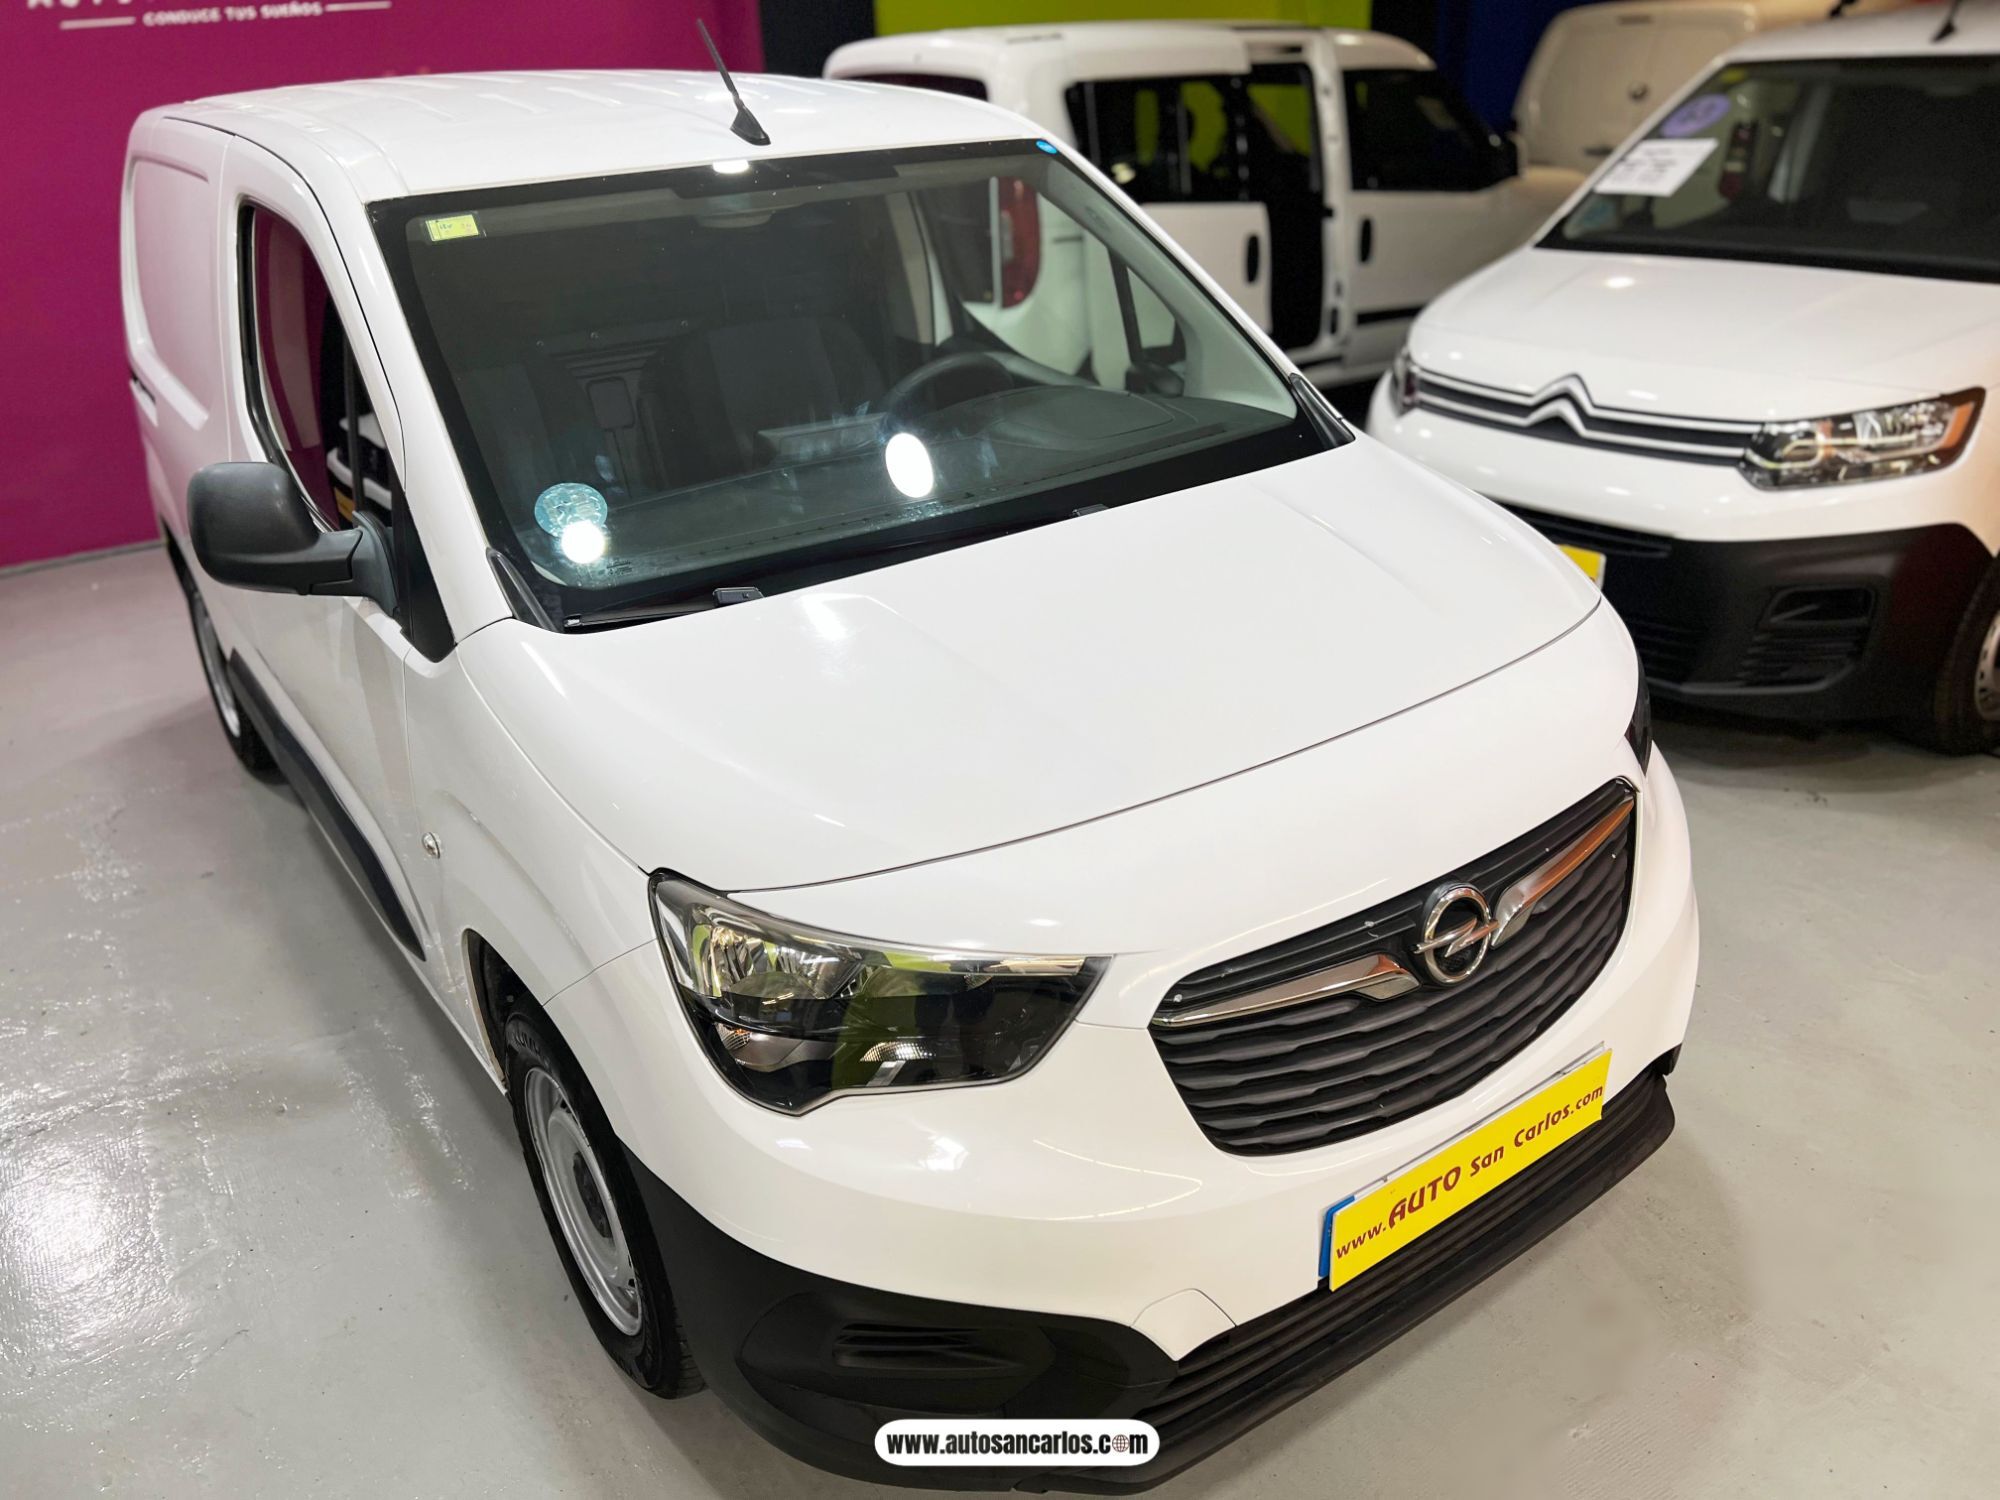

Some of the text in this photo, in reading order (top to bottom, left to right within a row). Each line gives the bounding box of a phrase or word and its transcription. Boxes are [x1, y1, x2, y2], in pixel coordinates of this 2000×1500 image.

[143, 1, 323, 26] CONDUCE TUS SUEÑOS
[1470, 1145, 1504, 1177] San
[1514, 1086, 1603, 1148] Carlos.com
